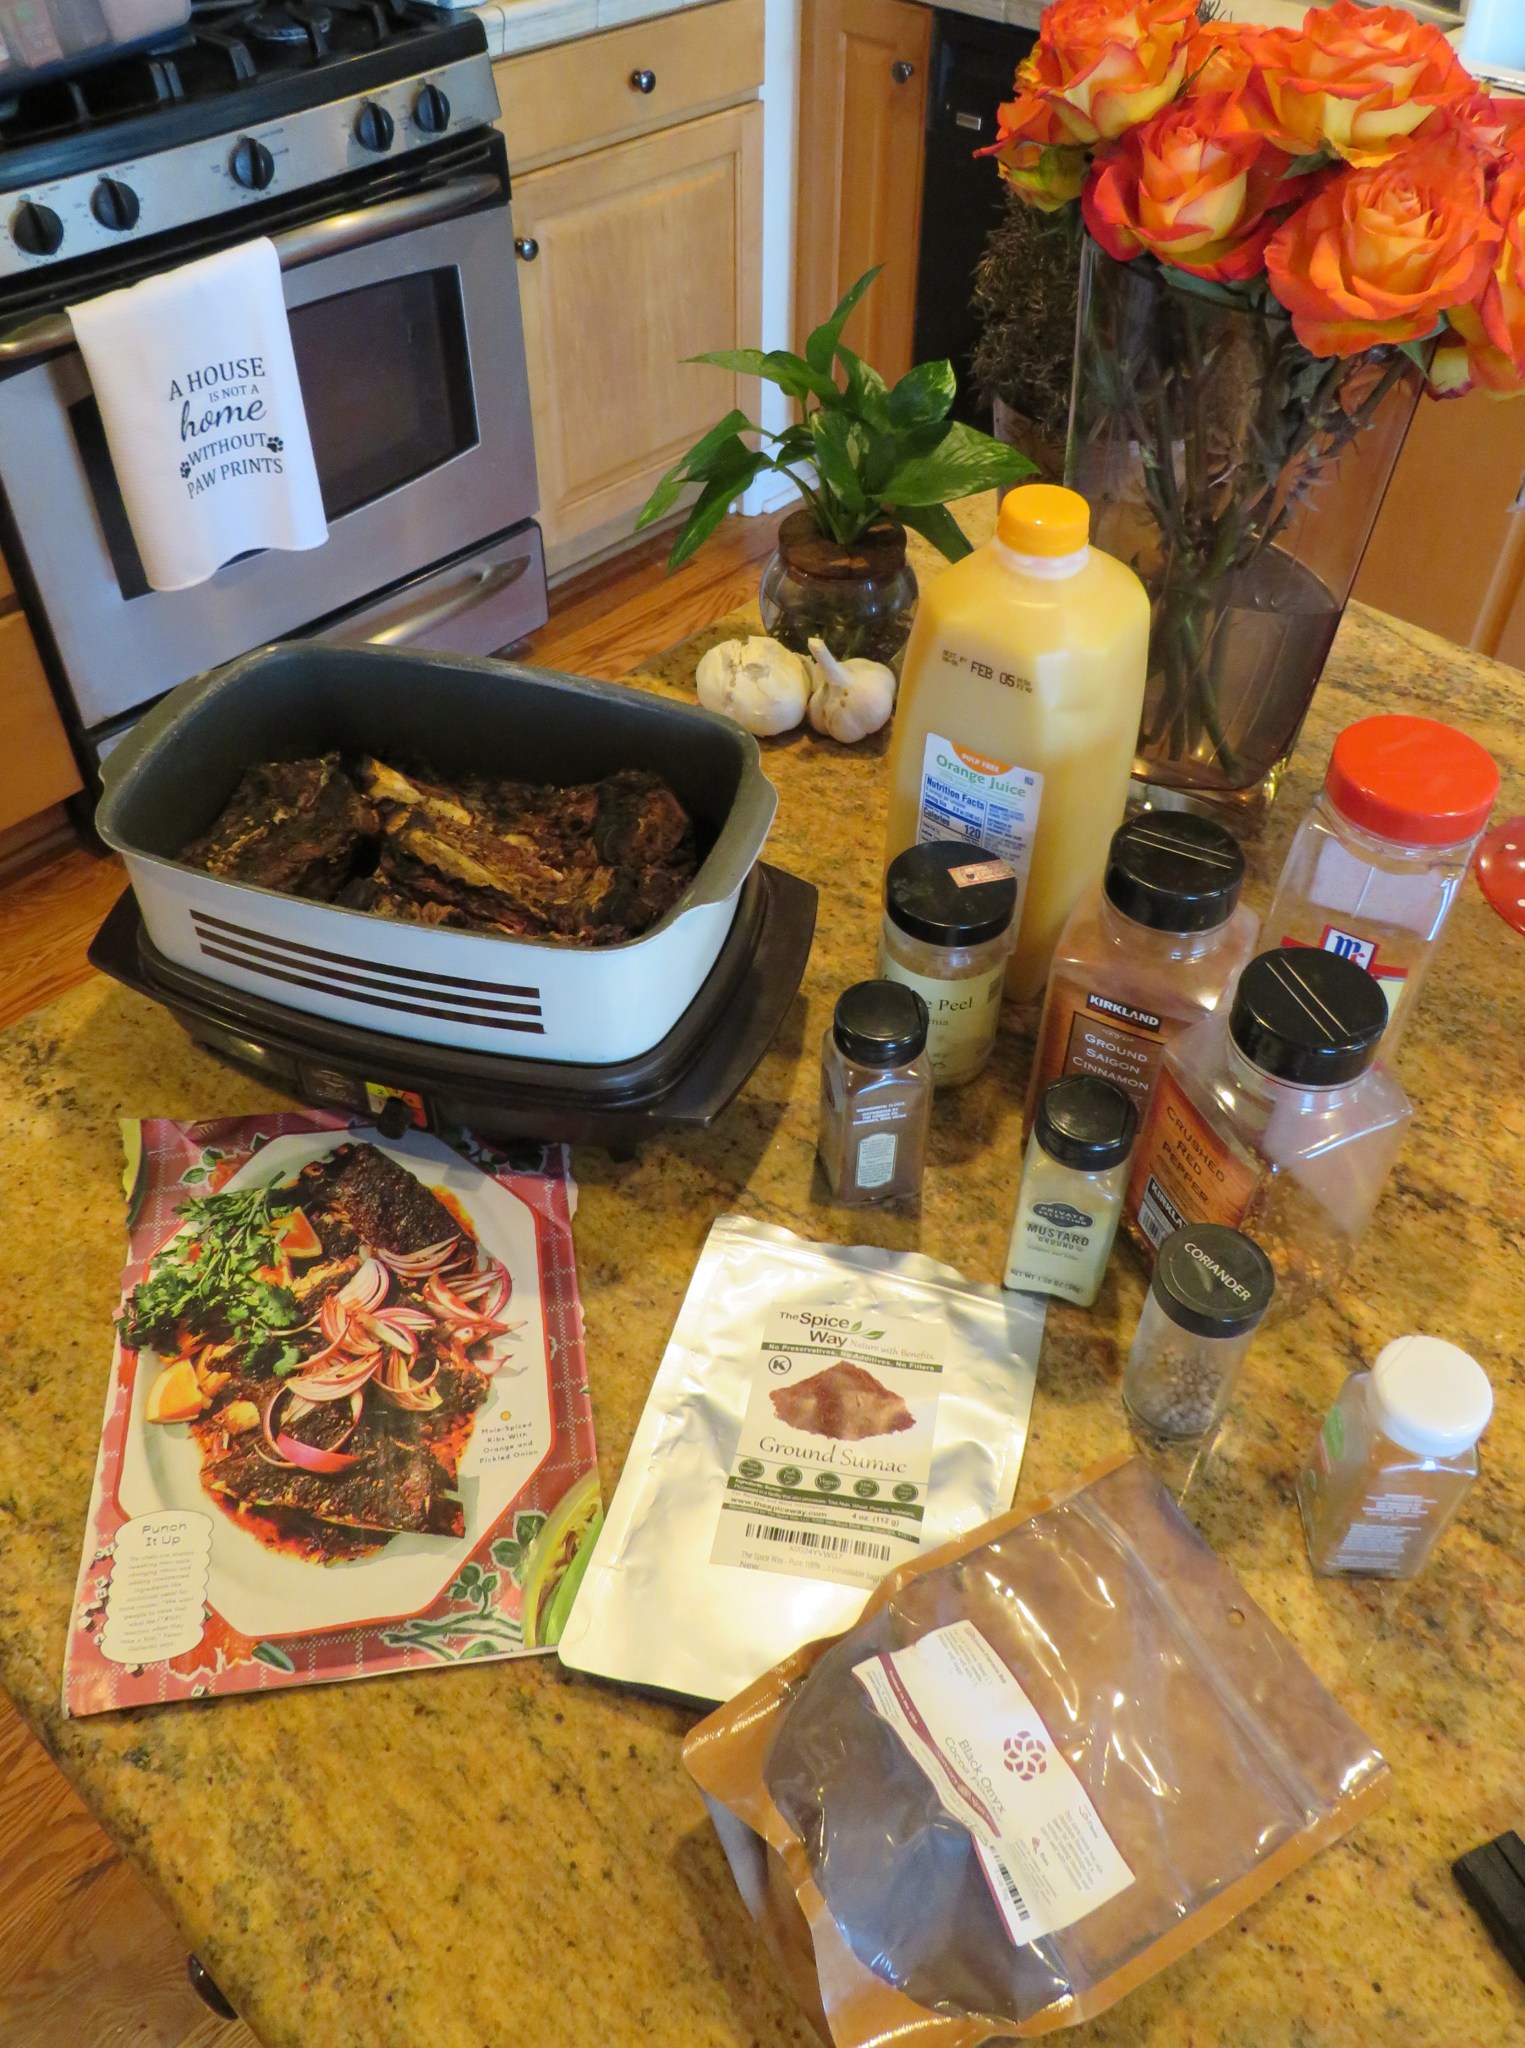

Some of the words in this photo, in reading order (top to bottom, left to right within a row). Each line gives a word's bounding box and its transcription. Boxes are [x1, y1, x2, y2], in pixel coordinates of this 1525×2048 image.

[169, 379, 183, 401] A
[187, 357, 265, 393] HOUSE
[209, 391, 219, 403] IS
[222, 385, 248, 399] NOT
[250, 384, 260, 395] A
[180, 400, 267, 443] home
[188, 432, 267, 466] WITHOUT
[187, 468, 217, 499] PAW
[220, 457, 284, 481] PRINTS
[970, 661, 993, 680] FEB
[999, 672, 1016, 687] 05
[937, 754, 985, 784] Orange
[989, 776, 1026, 797] Juice
[962, 753, 980, 765] PULP
[982, 760, 999, 773] FREE
[927, 776, 960, 799] Nutrition
[962, 794, 985, 810] Facts
[924, 807, 950, 826] Calories
[964, 824, 981, 838] 120
[939, 997, 972, 1011] Peel
[1089, 995, 1159, 1026] KIRKLAND
[1084, 1033, 1148, 1062] GROUND
[1072, 1056, 1150, 1091] CINNAMON
[1086, 1048, 1141, 1075] SAIGON
[1167, 1106, 1225, 1182] CRUSHED
[1176, 1140, 1202, 1175] RED
[1162, 1141, 1209, 1205] PEPPER
[1041, 1206, 1085, 1220] PRIVATE
[1027, 1224, 1089, 1246] MUSTARD
[1038, 1237, 1074, 1249] GROUND
[1184, 1243, 1251, 1301] CORIANDER
[779, 1311, 799, 1321] The
[800, 1312, 850, 1329] Spice
[810, 1330, 848, 1347] Way
[850, 1339, 879, 1351] Nature
[880, 1345, 899, 1356] with
[773, 1359, 786, 1370] K
[483, 1445, 514, 1453] Orange
[508, 1432, 527, 1440] With
[480, 1454, 510, 1463] Pickled
[514, 1450, 538, 1458] Onion
[759, 1436, 836, 1464] Ground
[840, 1449, 907, 1474] Sumac
[731, 1497, 827, 1517] www.thespiceway.com
[142, 1522, 187, 1534] Punch
[145, 1537, 157, 1547] It
[161, 1536, 181, 1546] Up
[739, 1561, 759, 1569] New
[945, 1736, 971, 1775] Cocoa
[958, 1738, 983, 1778] Black
[981, 1776, 1006, 1814] Onyx
